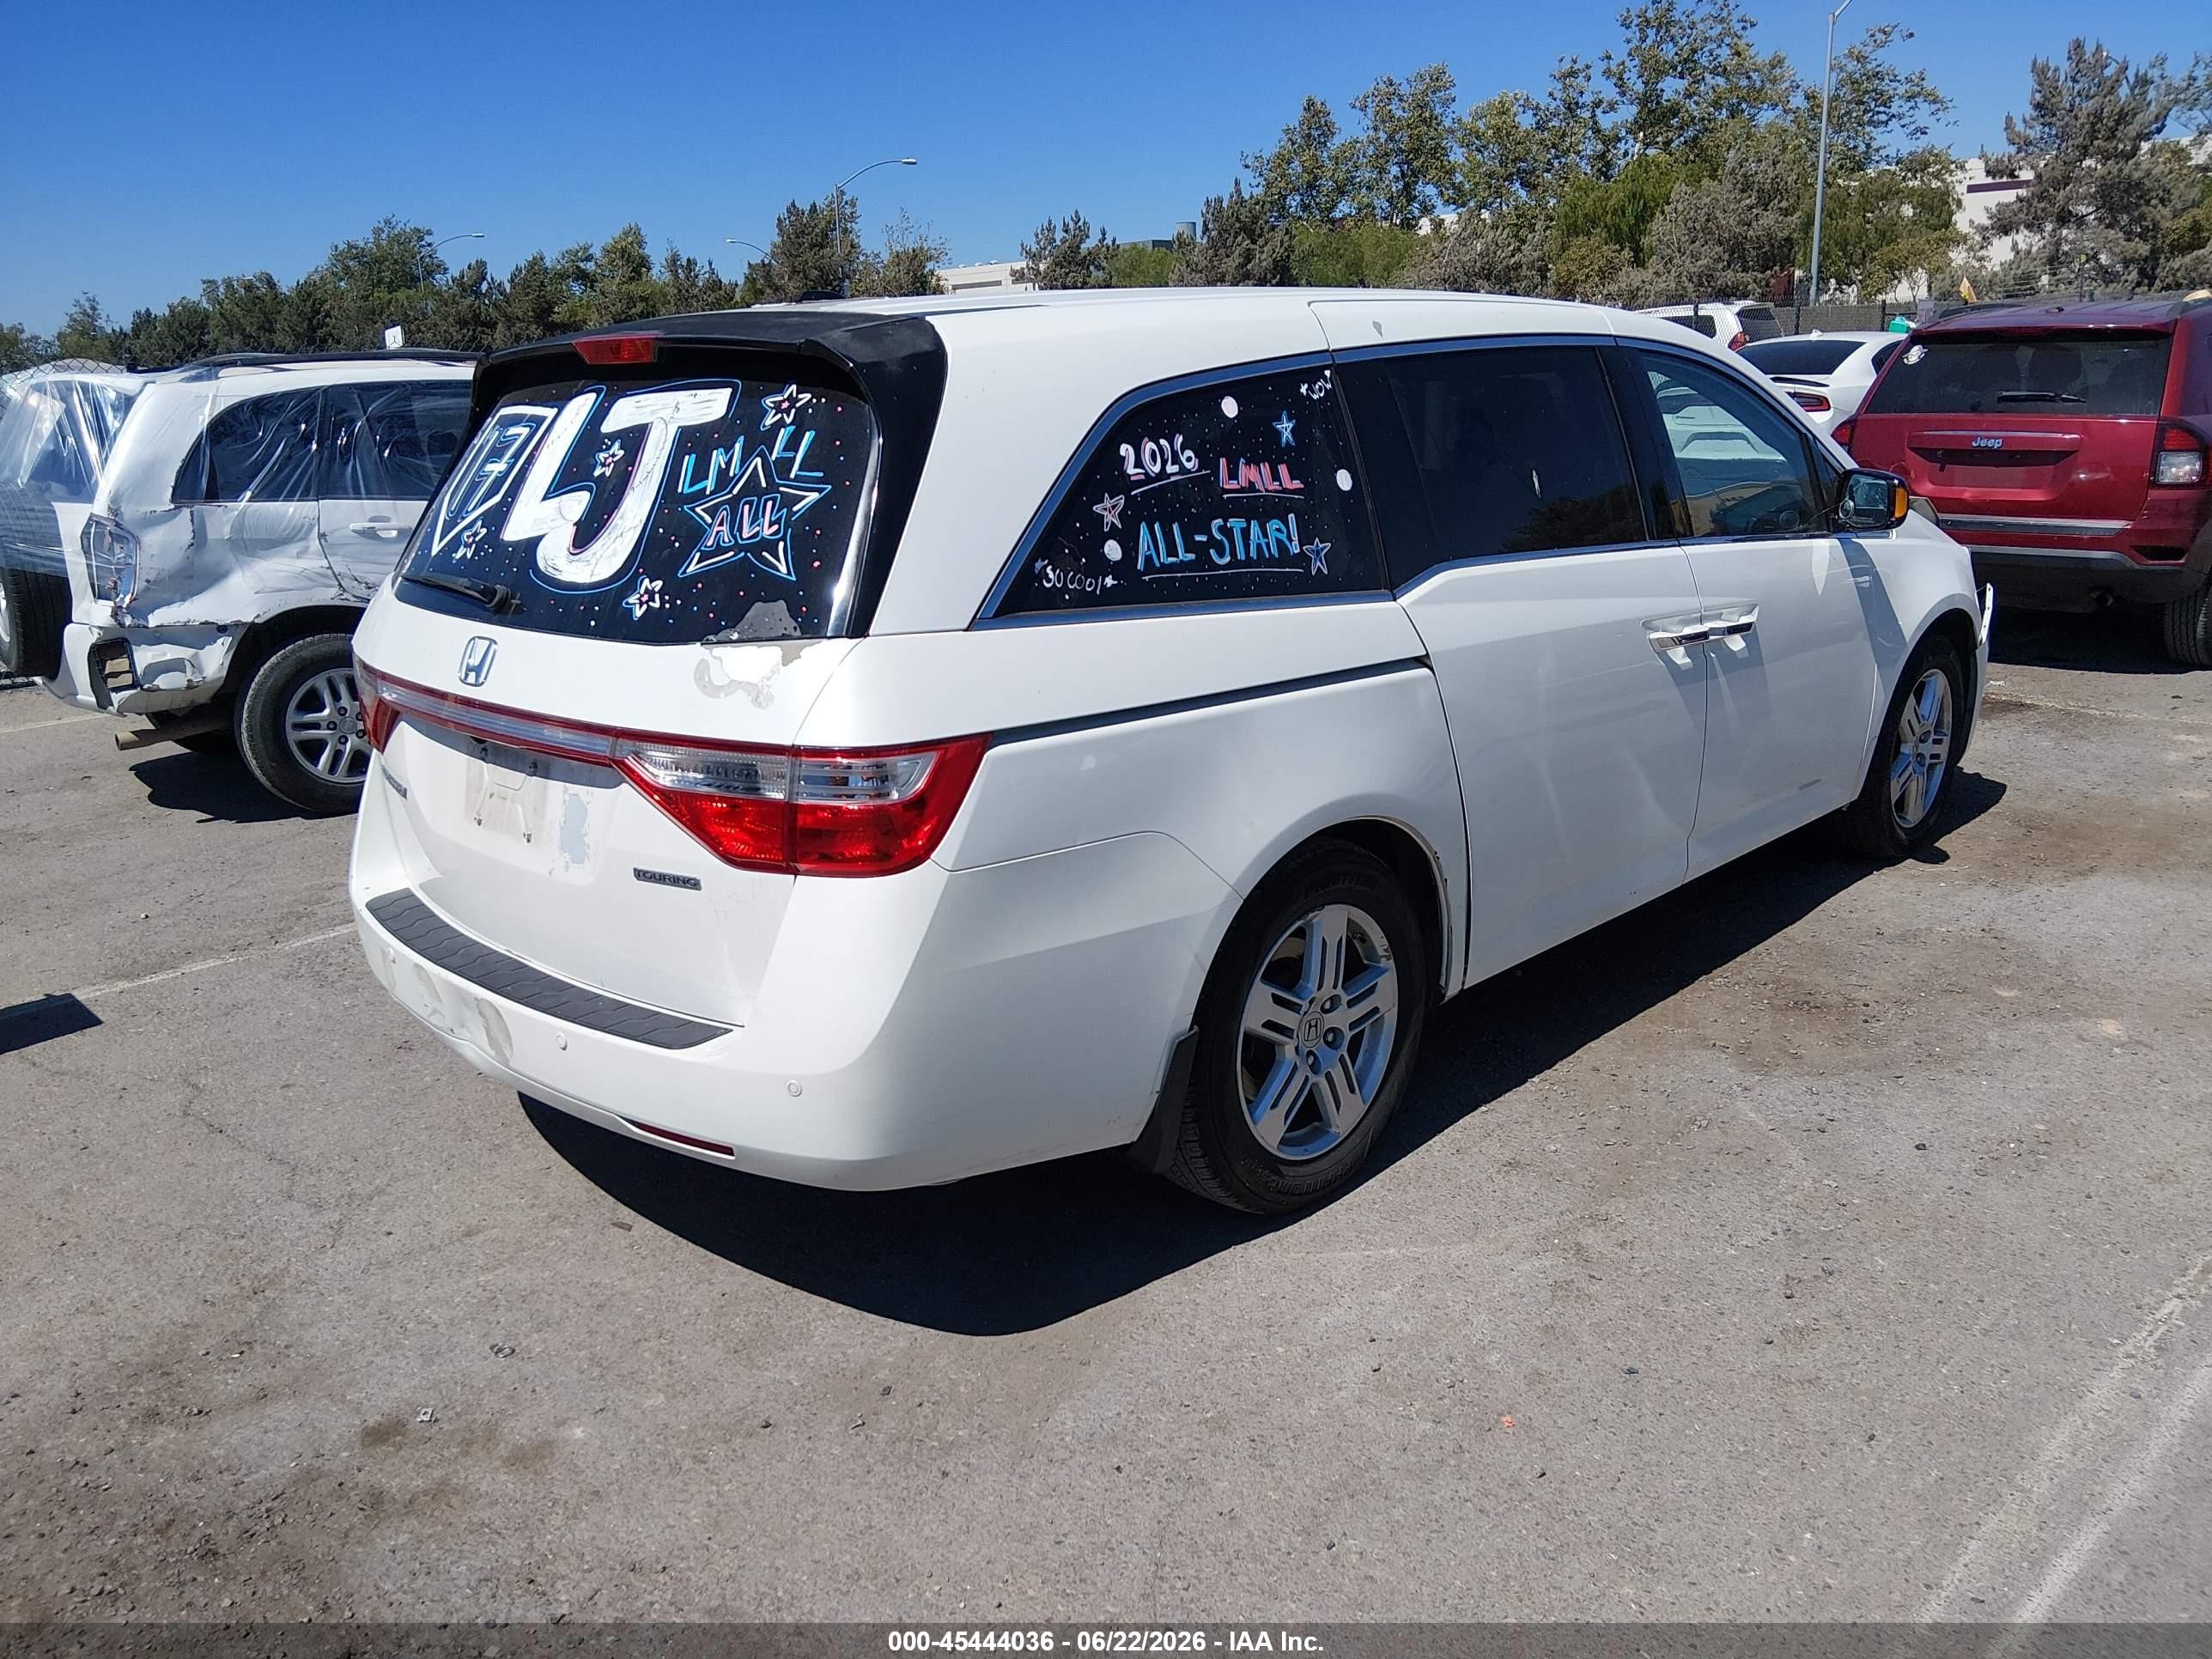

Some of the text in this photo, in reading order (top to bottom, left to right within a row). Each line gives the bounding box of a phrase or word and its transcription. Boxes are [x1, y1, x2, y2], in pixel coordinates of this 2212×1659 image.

[1120, 434, 1199, 481] 2026
[1971, 436, 2003, 449] Jeep
[1219, 457, 1304, 493] LMLL
[702, 495, 787, 550] ALL
[1137, 514, 1300, 571] ALL-STAR!
[635, 868, 699, 888] TOURING
